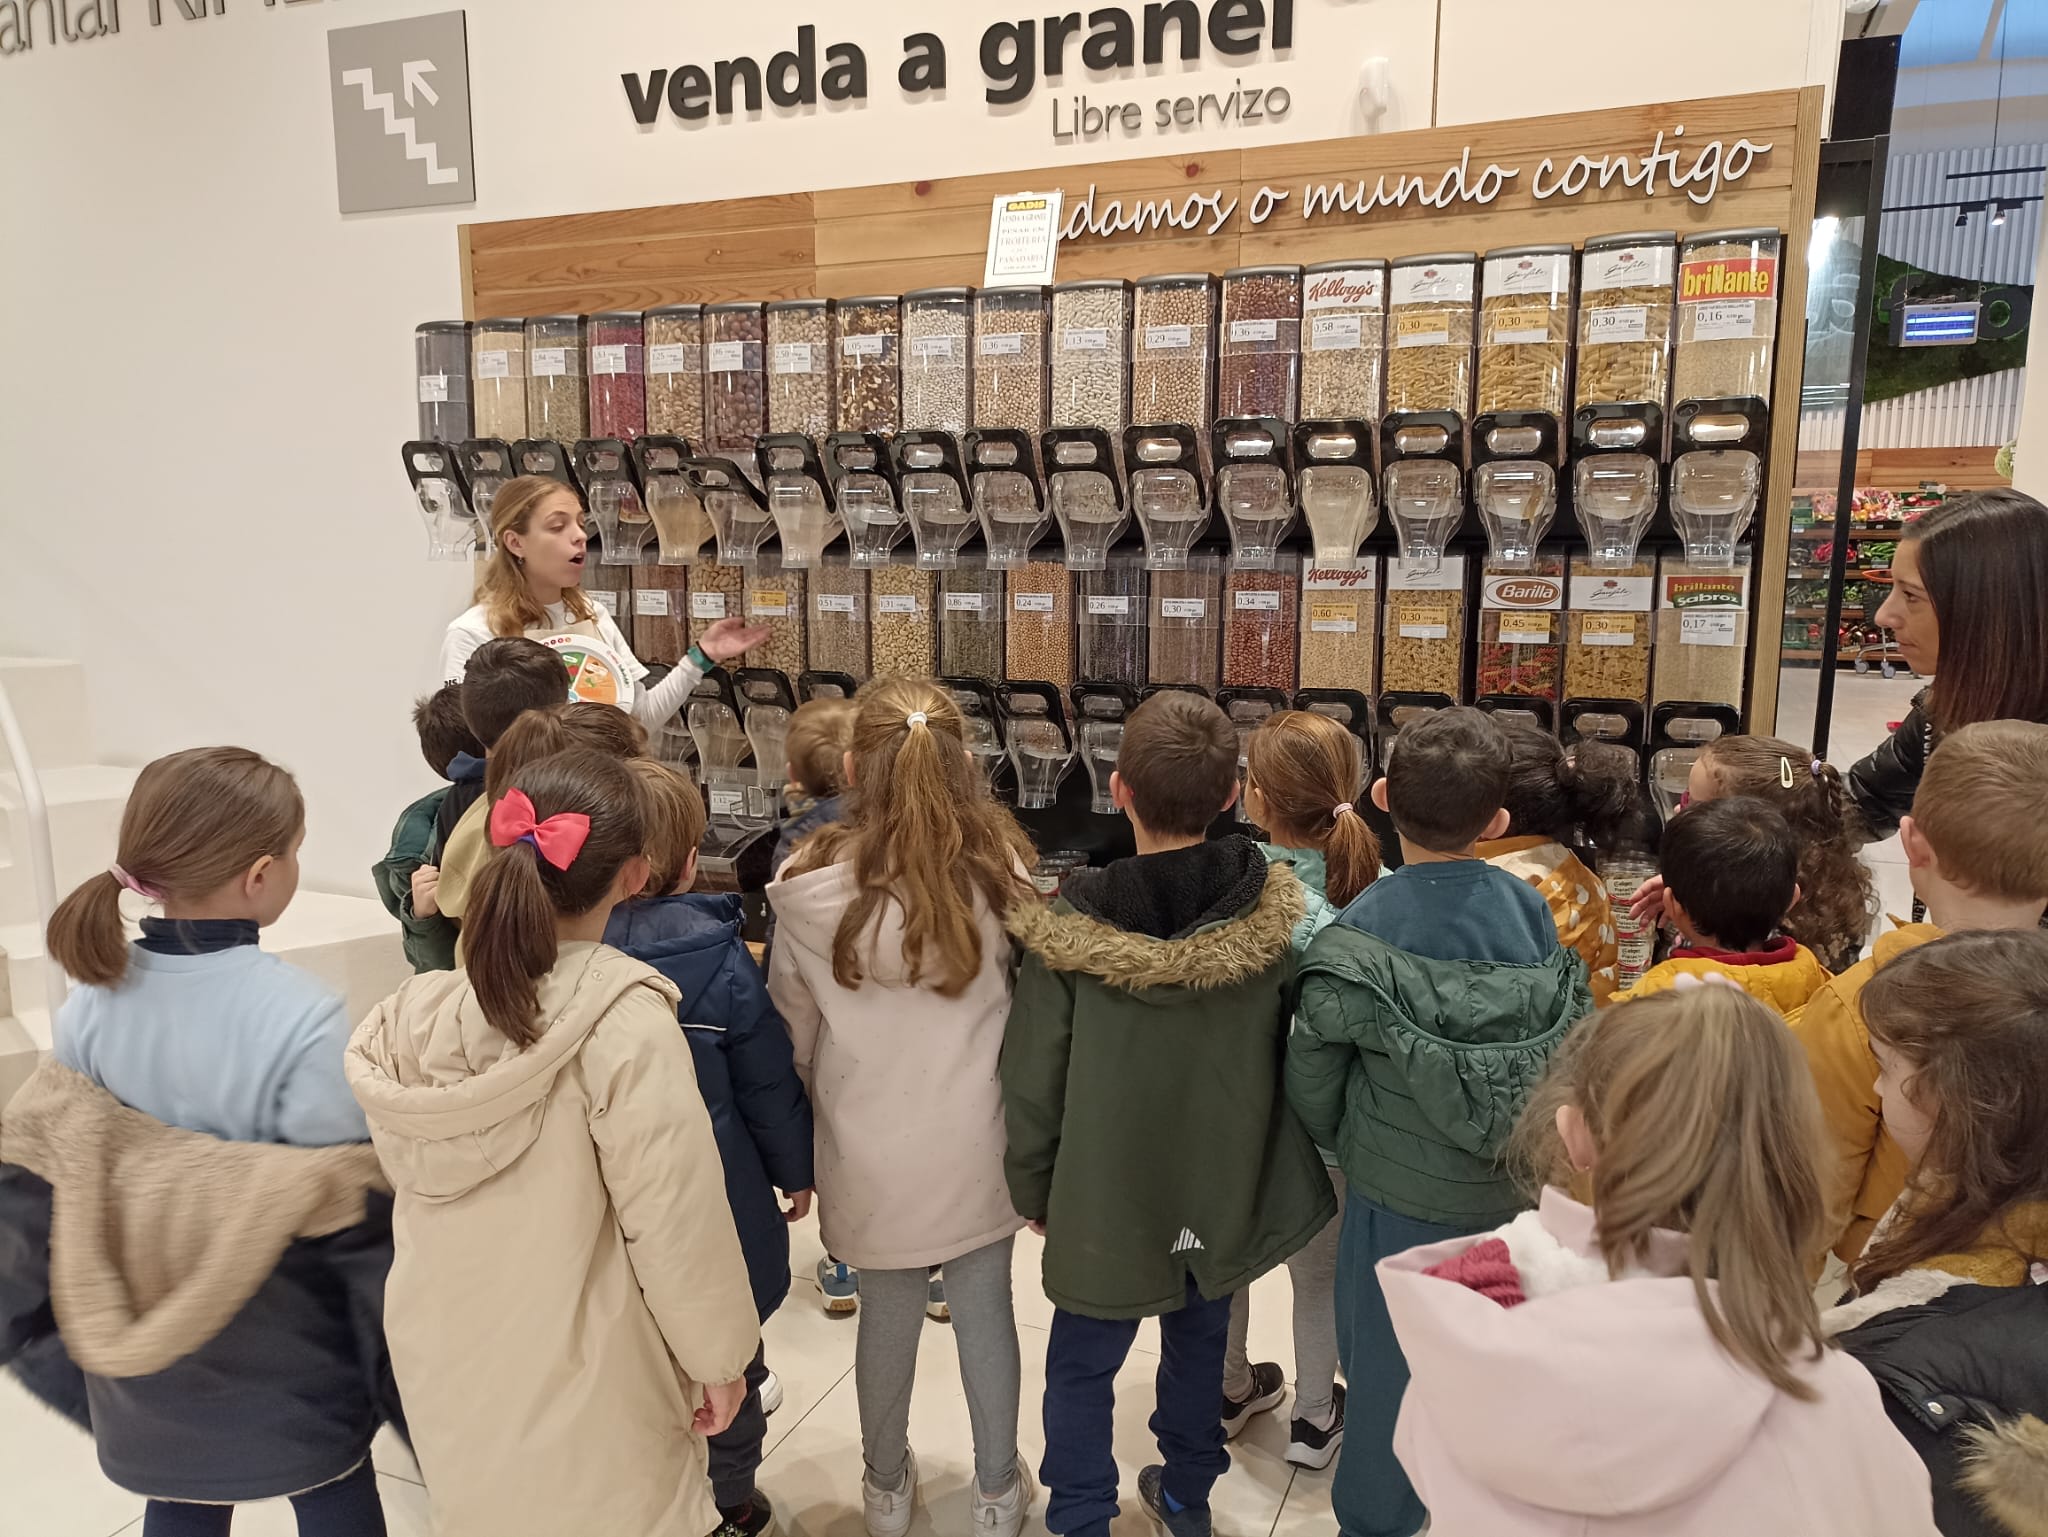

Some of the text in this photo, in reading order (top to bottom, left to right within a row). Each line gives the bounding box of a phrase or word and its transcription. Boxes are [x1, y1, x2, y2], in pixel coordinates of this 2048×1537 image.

[622, 25, 868, 124] venda
[898, 30, 947, 92] a
[1053, 79, 1291, 138] Libre servizo
[1249, 185, 1290, 224] o
[1302, 146, 1520, 220] mundo
[1531, 124, 1774, 204] contigo
[1007, 200, 1046, 211] GADIS
[1683, 263, 1769, 297] brillante
[1308, 277, 1375, 303] Kellogg's
[1498, 316, 1521, 328] 0,30
[1592, 316, 1616, 328] 0,30
[1697, 310, 1723, 323] 0,16
[1308, 566, 1369, 586] Kellogg's
[1501, 584, 1554, 599] Barilla
[1400, 612, 1421, 622] 0,30
[1503, 618, 1525, 628] 0,45
[1682, 618, 1706, 629] 0,17
